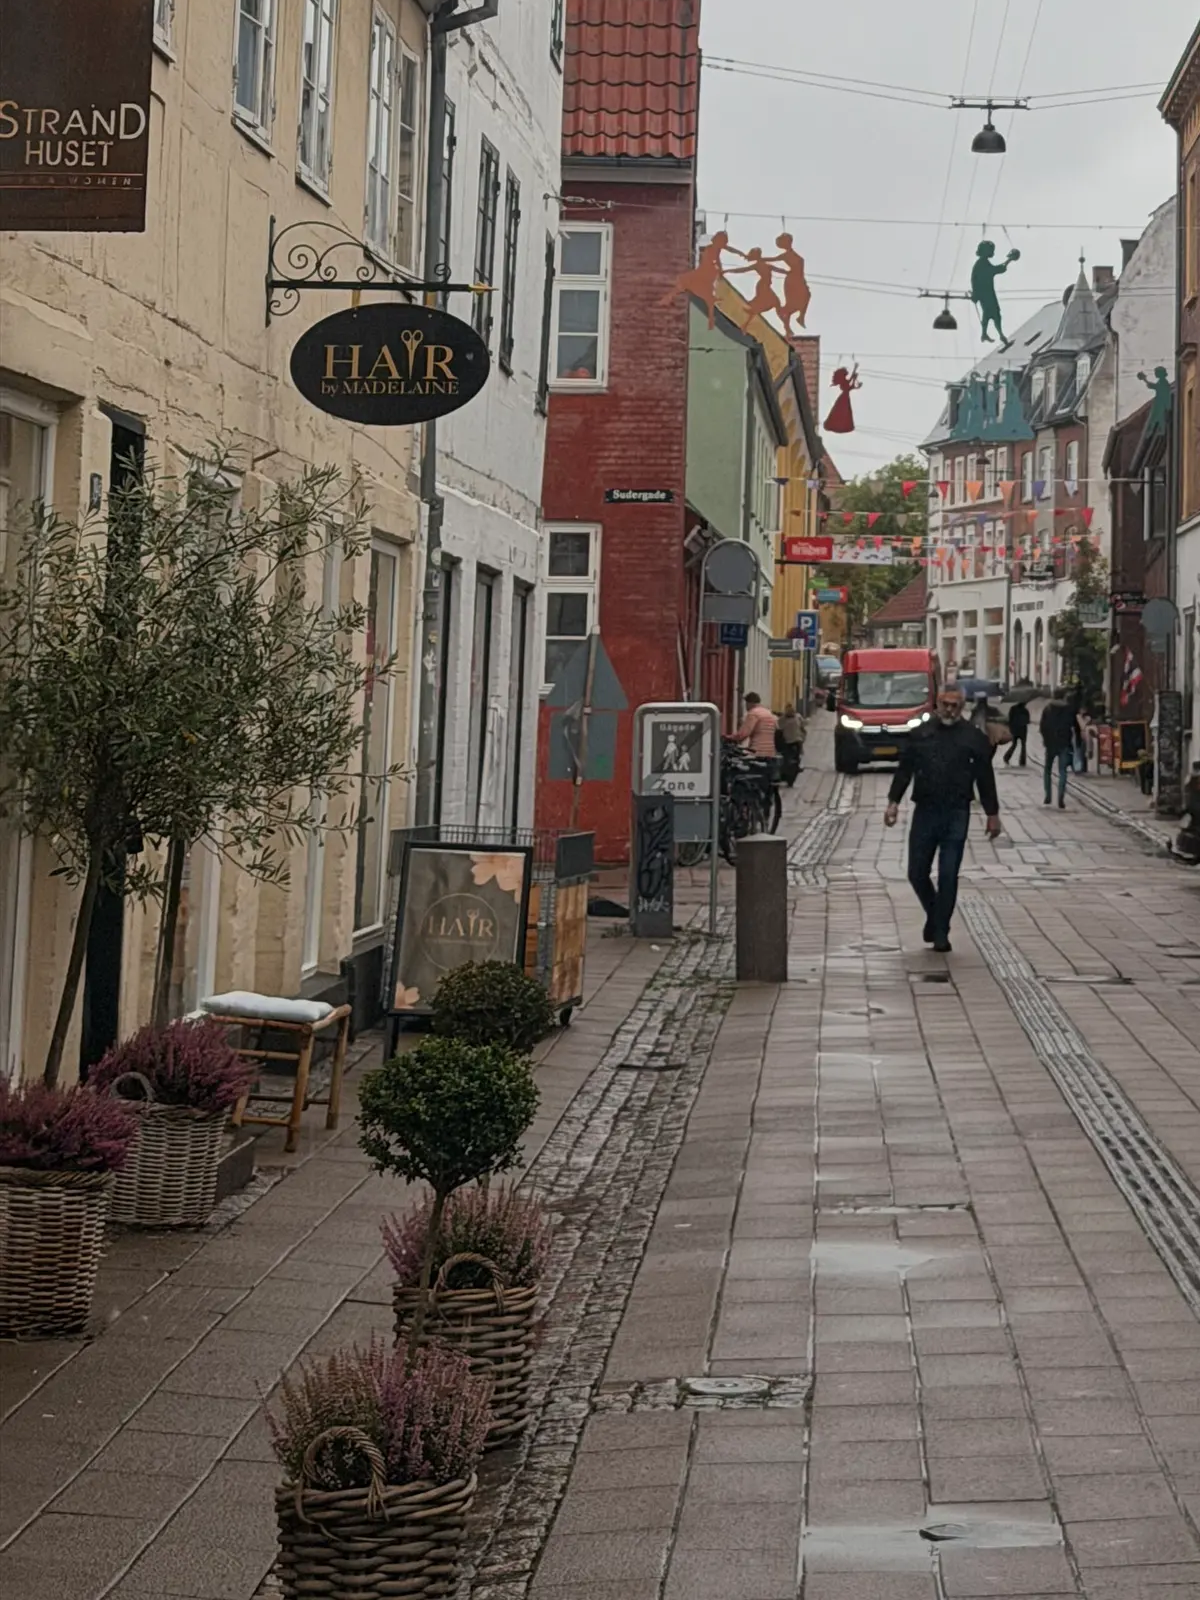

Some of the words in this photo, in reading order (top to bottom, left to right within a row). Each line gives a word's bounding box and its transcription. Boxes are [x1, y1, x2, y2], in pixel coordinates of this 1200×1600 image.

[25, 140, 114, 166] HUSET
[321, 329, 459, 380] HAIR
[321, 381, 339, 396] by
[342, 380, 459, 395] MADELAINE
[612, 489, 666, 502] Sudergade
[800, 616, 813, 631] P
[656, 779, 696, 791] Zone
